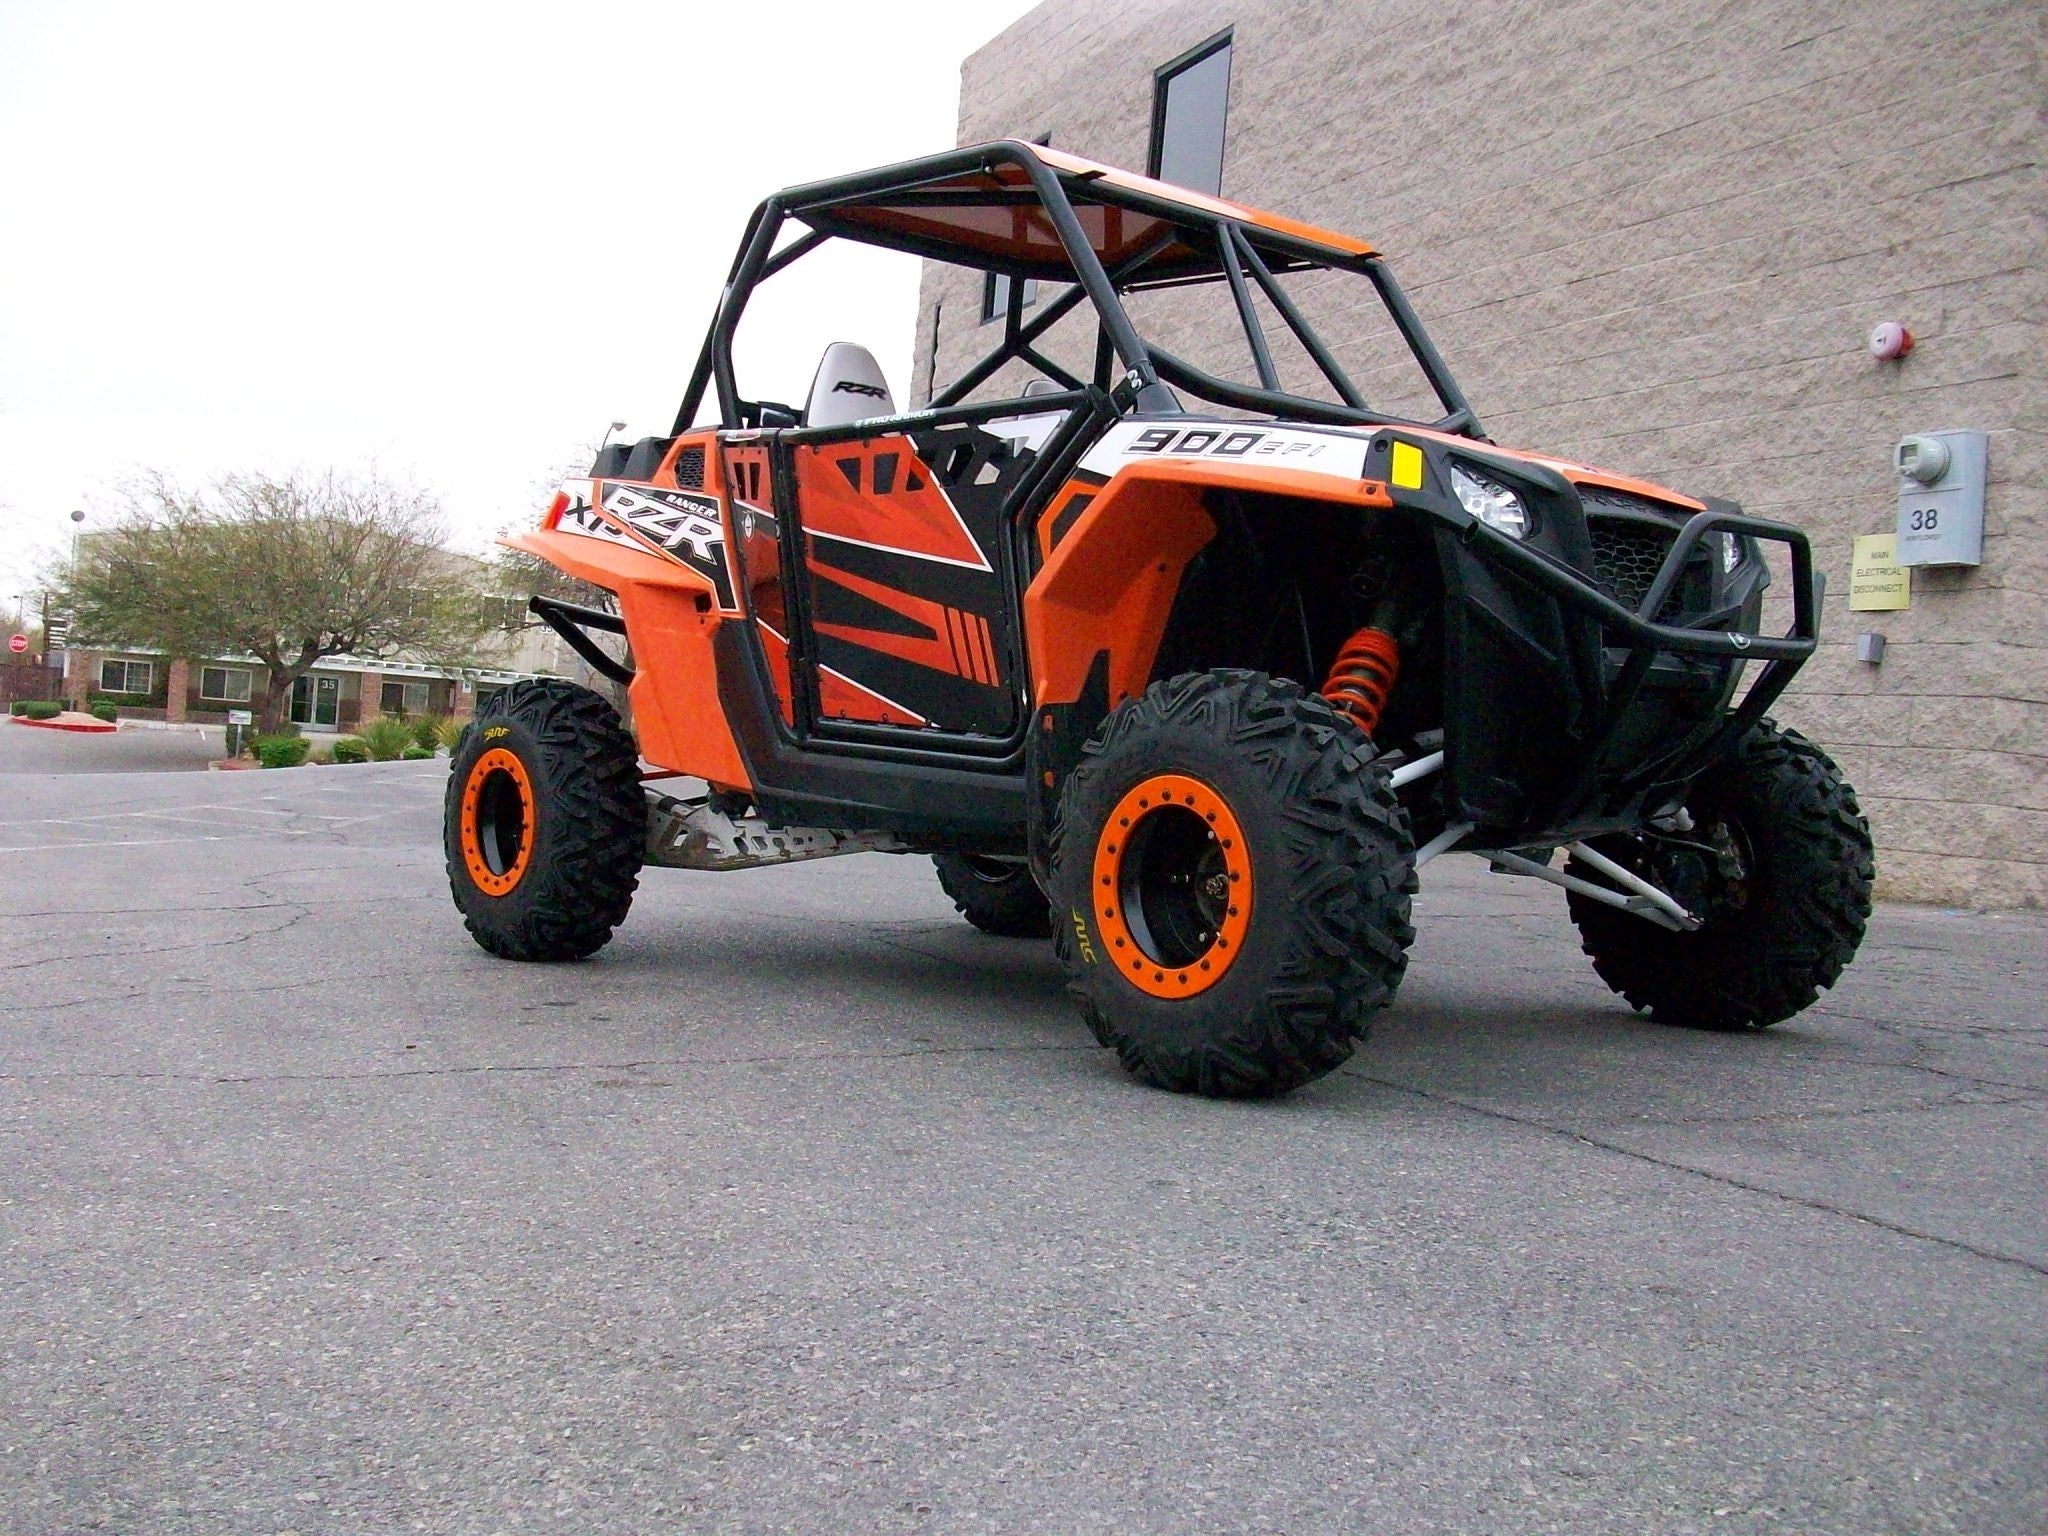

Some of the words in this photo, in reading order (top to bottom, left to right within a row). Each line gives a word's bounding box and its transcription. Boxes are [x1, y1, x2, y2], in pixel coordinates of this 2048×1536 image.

[831, 381, 886, 400] RZR
[1122, 426, 1272, 457] 900
[1255, 441, 1327, 457] EFI
[665, 494, 718, 519] RANGER
[602, 485, 726, 565] RZR
[1910, 508, 1938, 531] 38
[1871, 551, 1889, 559] MAIN
[1856, 567, 1902, 577] ELECTRICAL
[1853, 584, 1903, 594] DISCONNECT
[322, 680, 335, 690] 35
